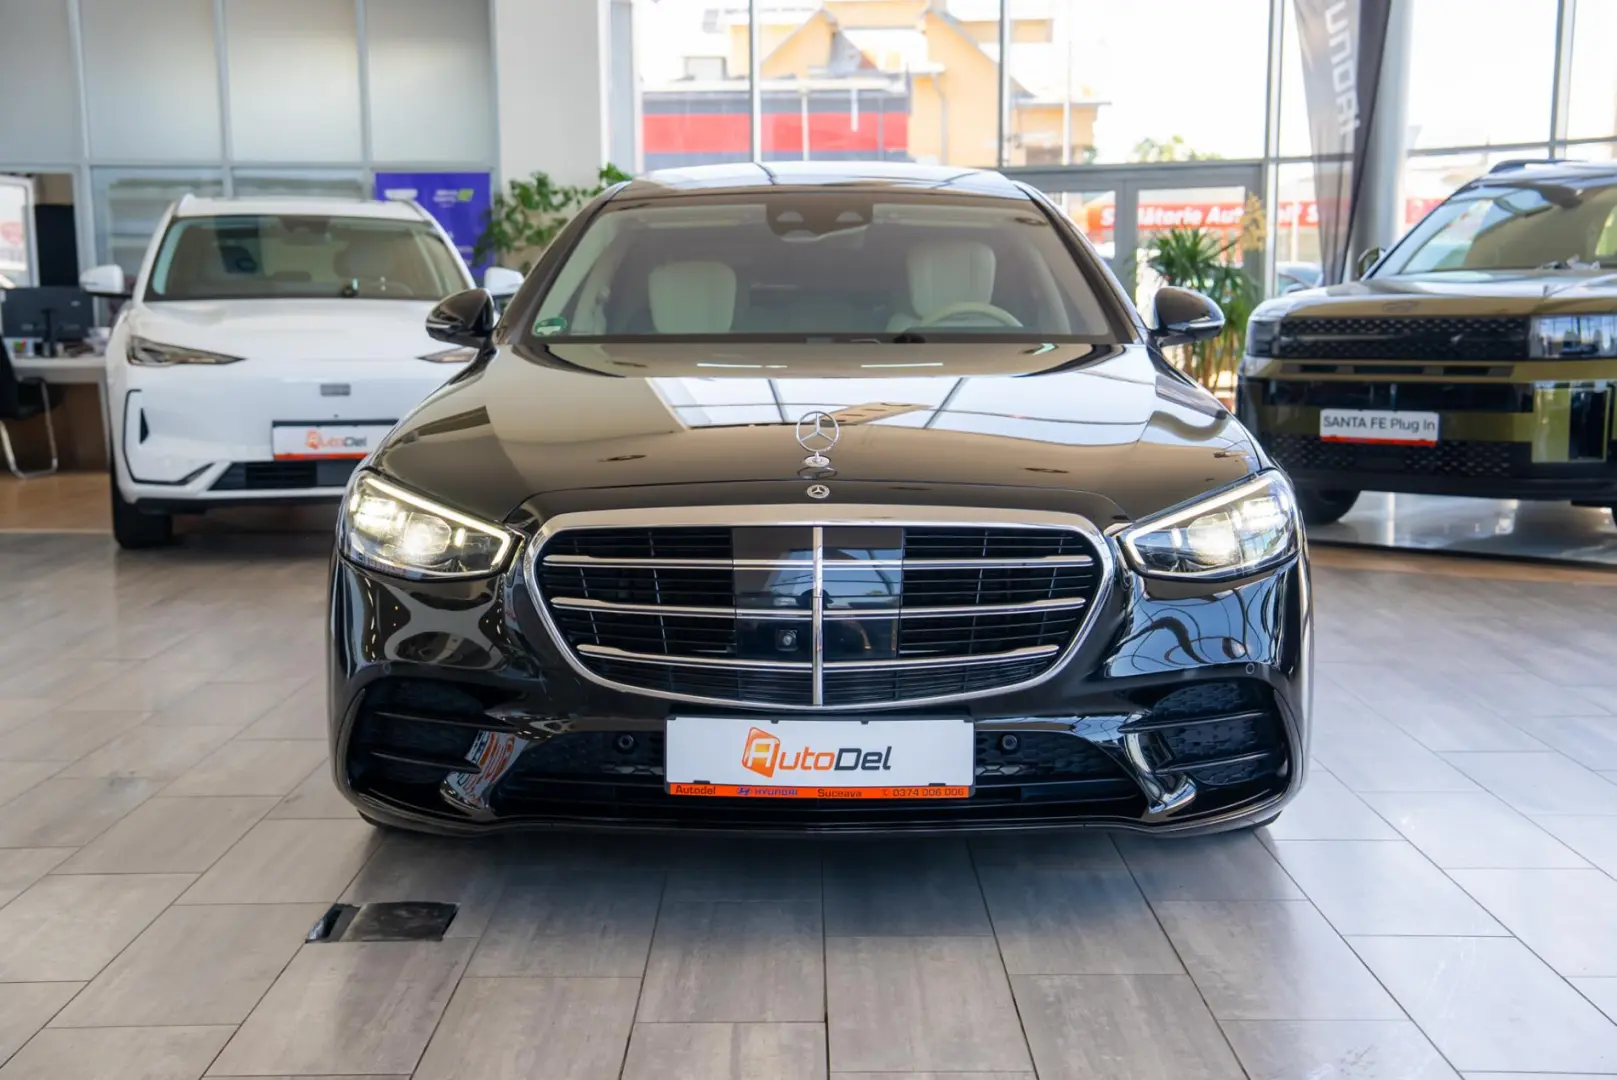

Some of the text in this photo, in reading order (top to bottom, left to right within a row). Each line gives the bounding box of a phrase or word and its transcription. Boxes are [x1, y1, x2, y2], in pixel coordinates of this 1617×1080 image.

[1323, 416, 1436, 433] SANTA FE Plug In
[745, 735, 893, 772] AutoDel
[675, 784, 716, 795] Autodel
[817, 788, 863, 798] Suceava
[892, 788, 920, 797] 0374
